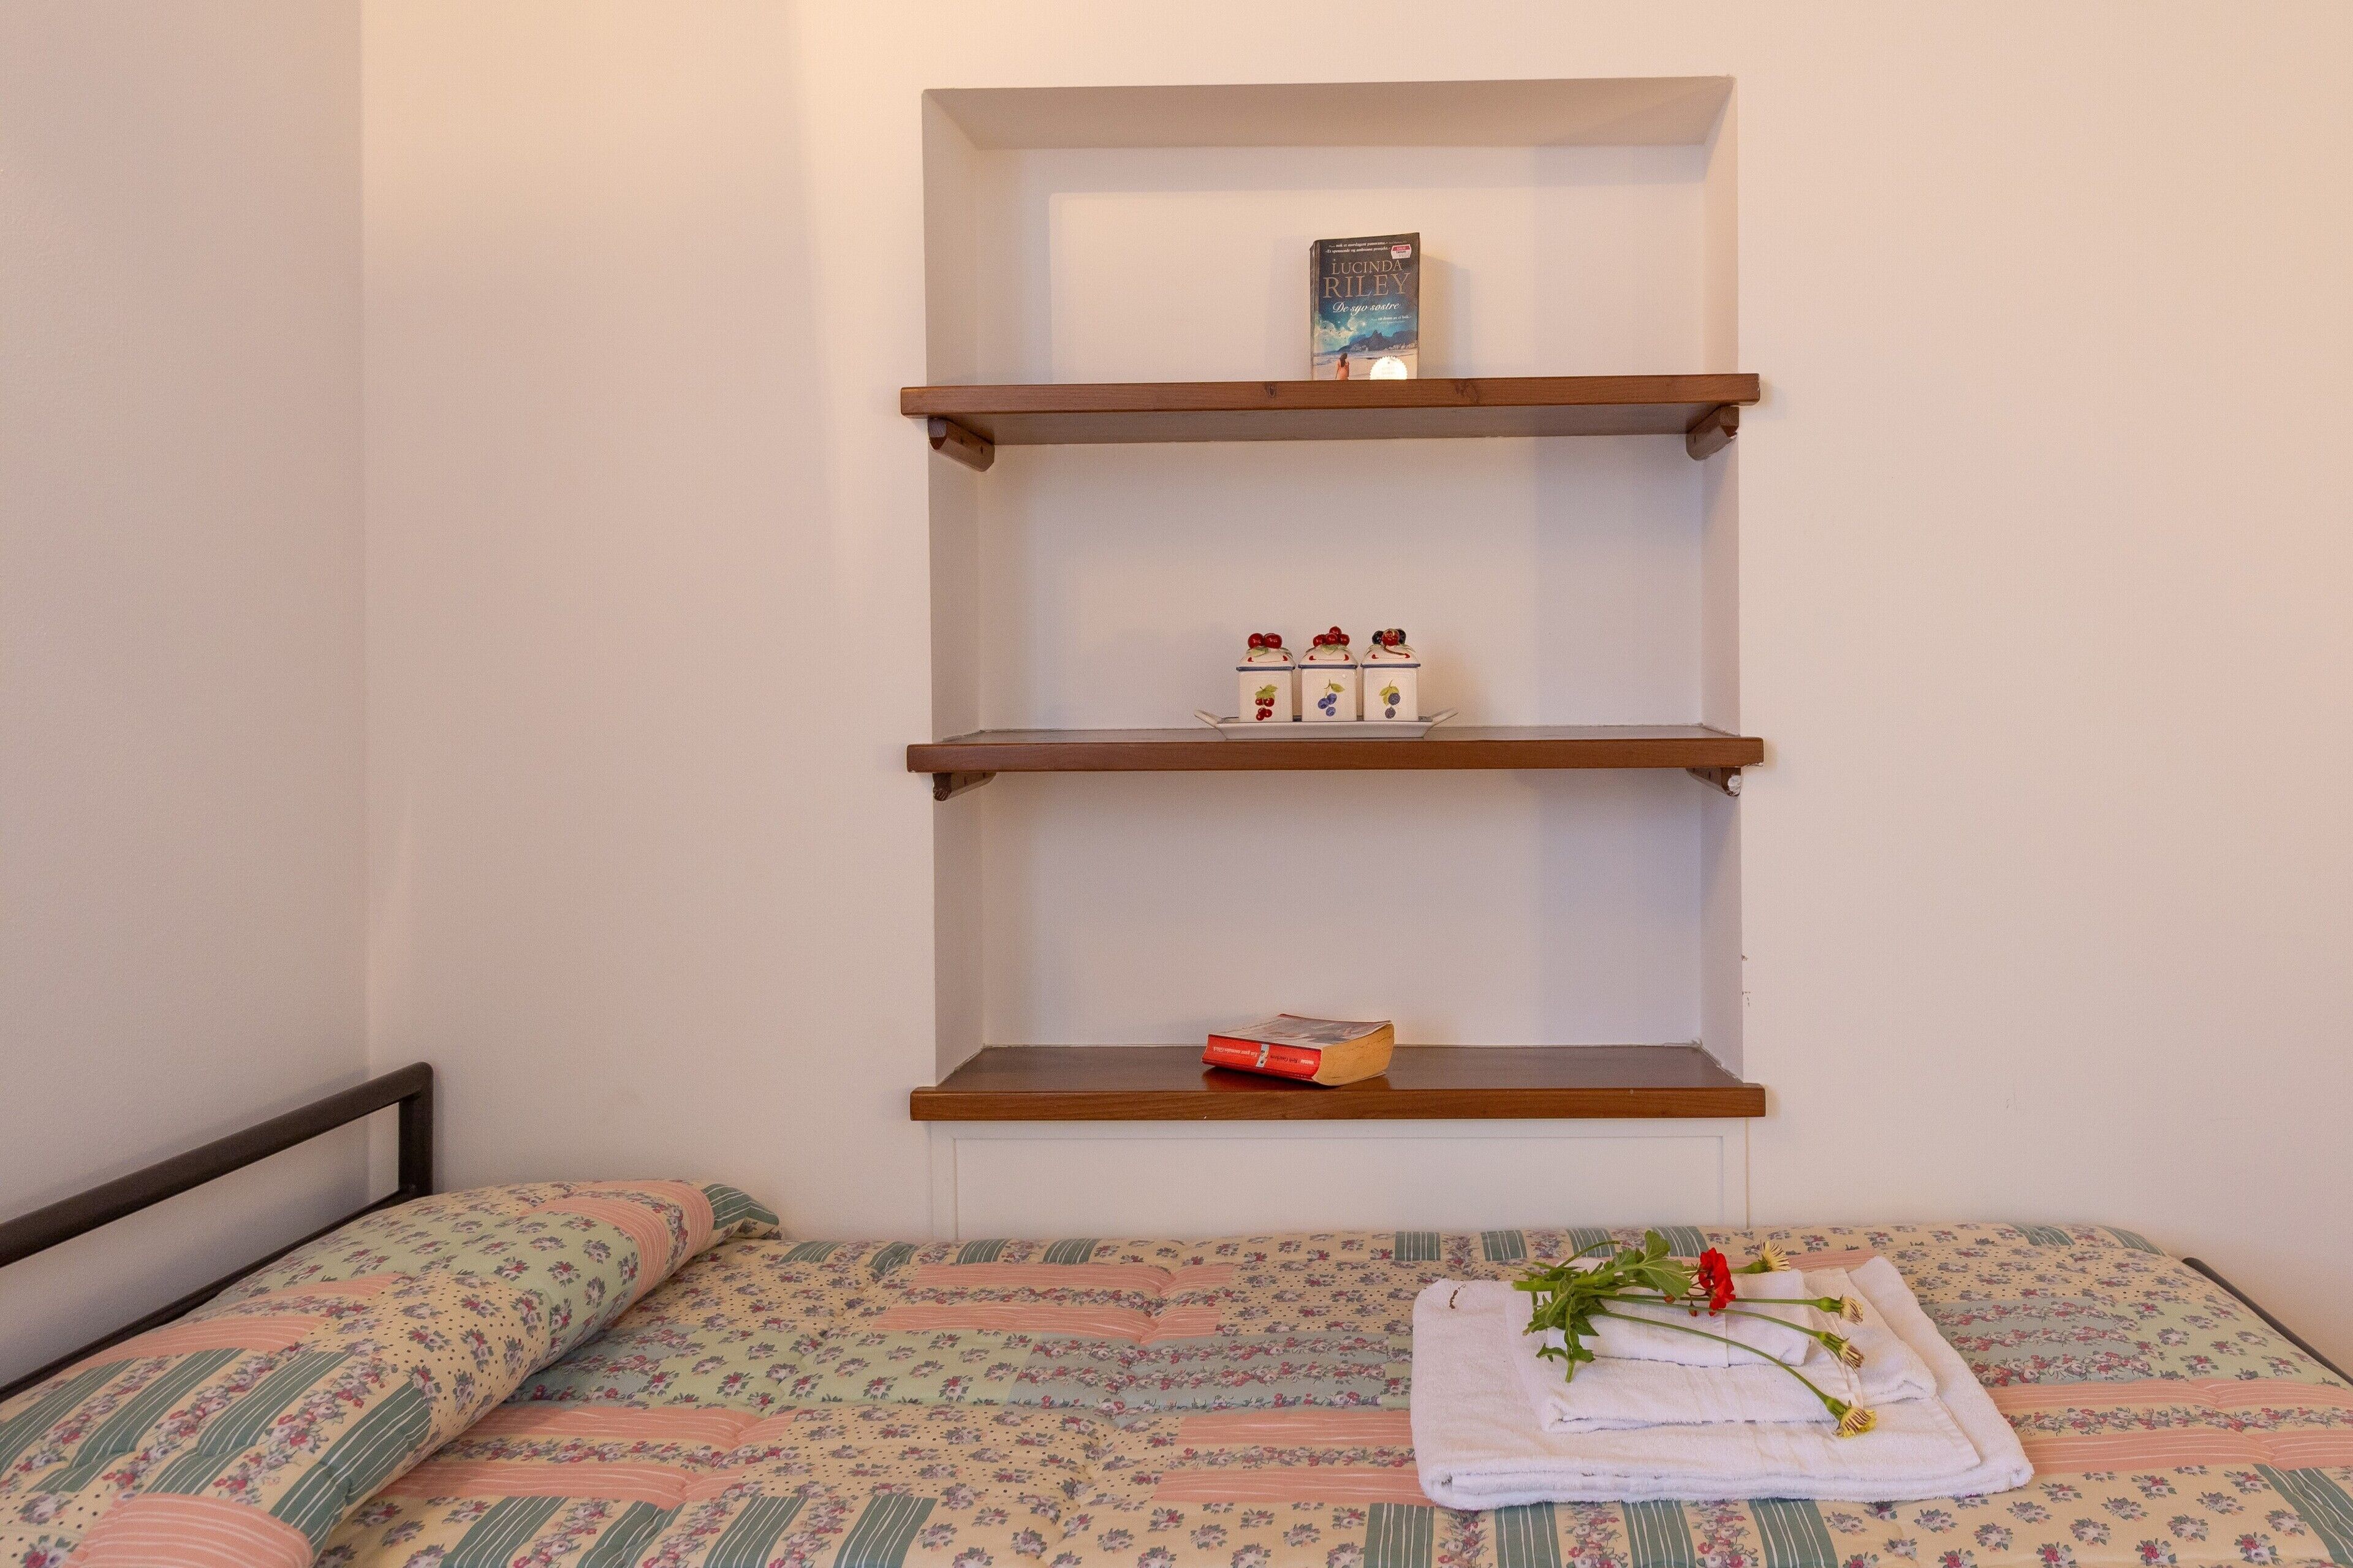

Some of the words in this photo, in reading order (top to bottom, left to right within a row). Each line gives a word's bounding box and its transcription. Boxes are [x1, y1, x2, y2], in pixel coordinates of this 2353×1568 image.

[1332, 260, 1403, 275] LUCINDA
[1323, 273, 1411, 298] RILEY
[1333, 301, 1349, 313] De
[1350, 305, 1368, 316] syv
[1370, 302, 1400, 311] søstre
